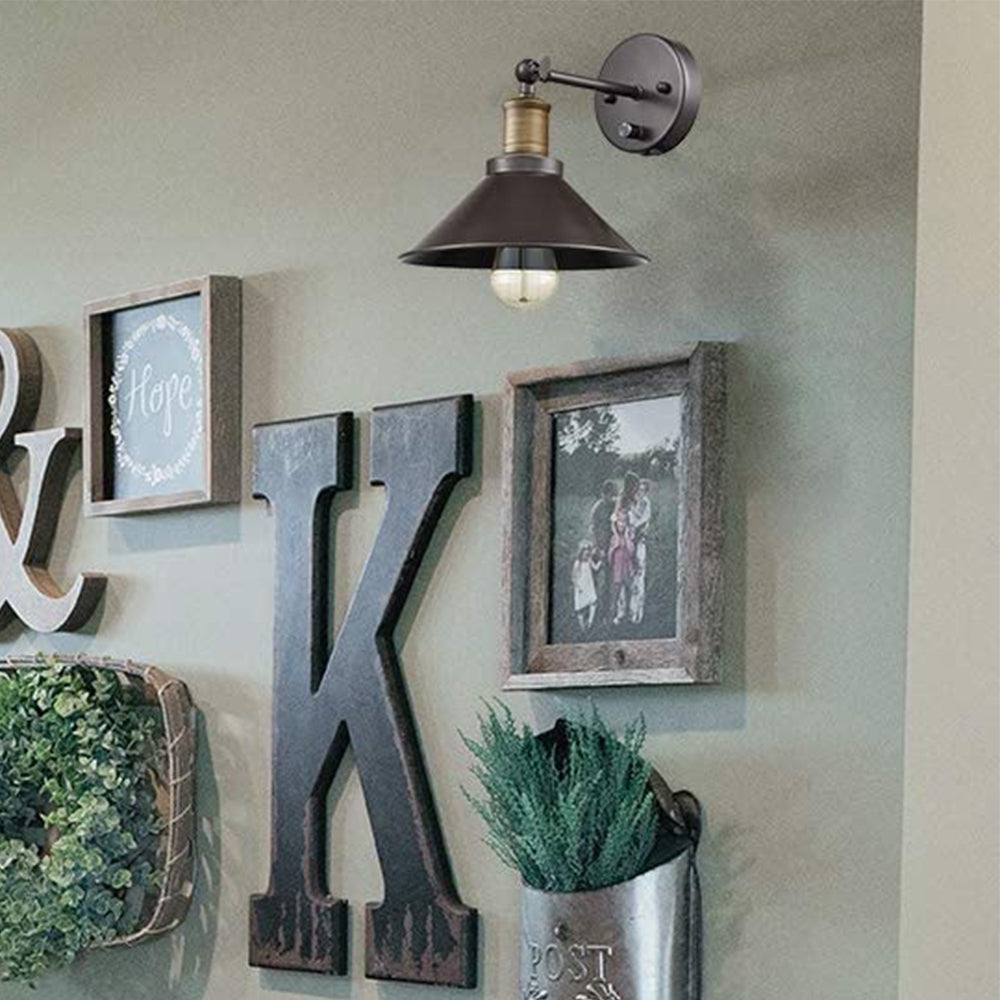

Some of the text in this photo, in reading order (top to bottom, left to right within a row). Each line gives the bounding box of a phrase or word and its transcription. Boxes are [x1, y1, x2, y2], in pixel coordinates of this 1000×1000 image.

[125, 363, 193, 437] Hope
[249, 394, 478, 988] K
[530, 942, 613, 982] POST
